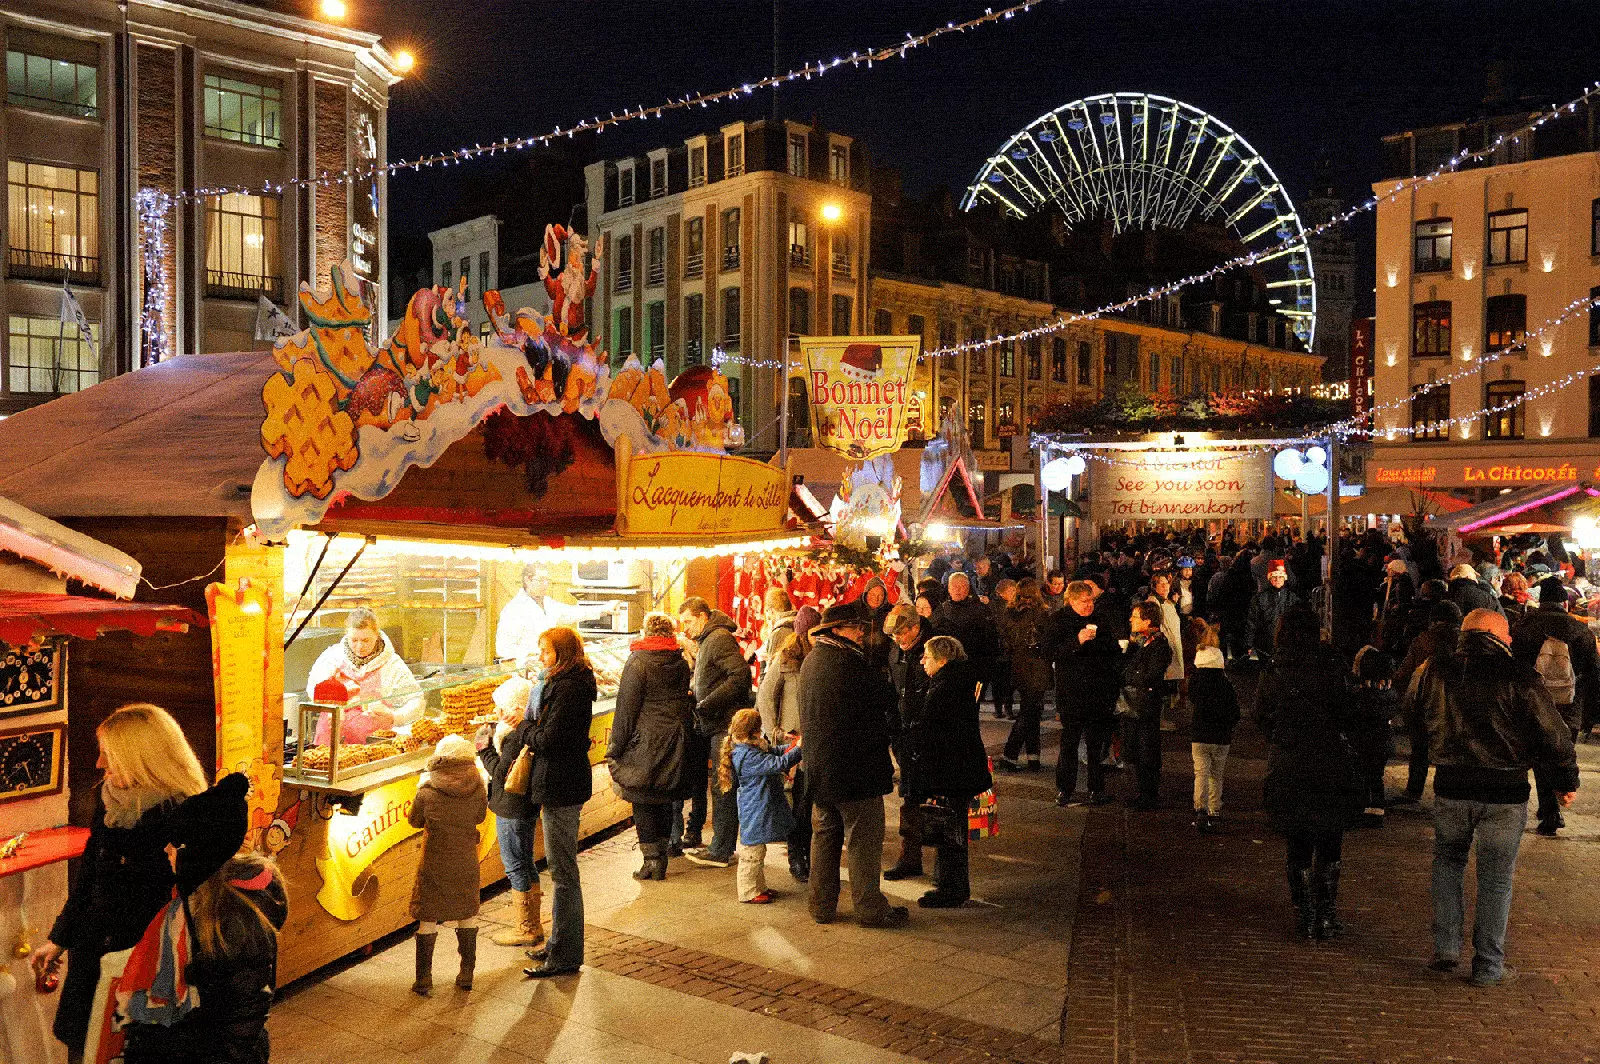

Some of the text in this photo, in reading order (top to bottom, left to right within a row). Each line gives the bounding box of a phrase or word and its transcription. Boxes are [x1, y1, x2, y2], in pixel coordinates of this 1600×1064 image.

[811, 369, 906, 405] Bonnet
[821, 407, 894, 440] de Noël
[1116, 476, 1245, 493] See you soon
[1464, 467, 1486, 481] LA
[743, 485, 753, 508] de
[756, 481, 781, 510] Lille
[1111, 499, 1250, 515] Tot binnenkort
